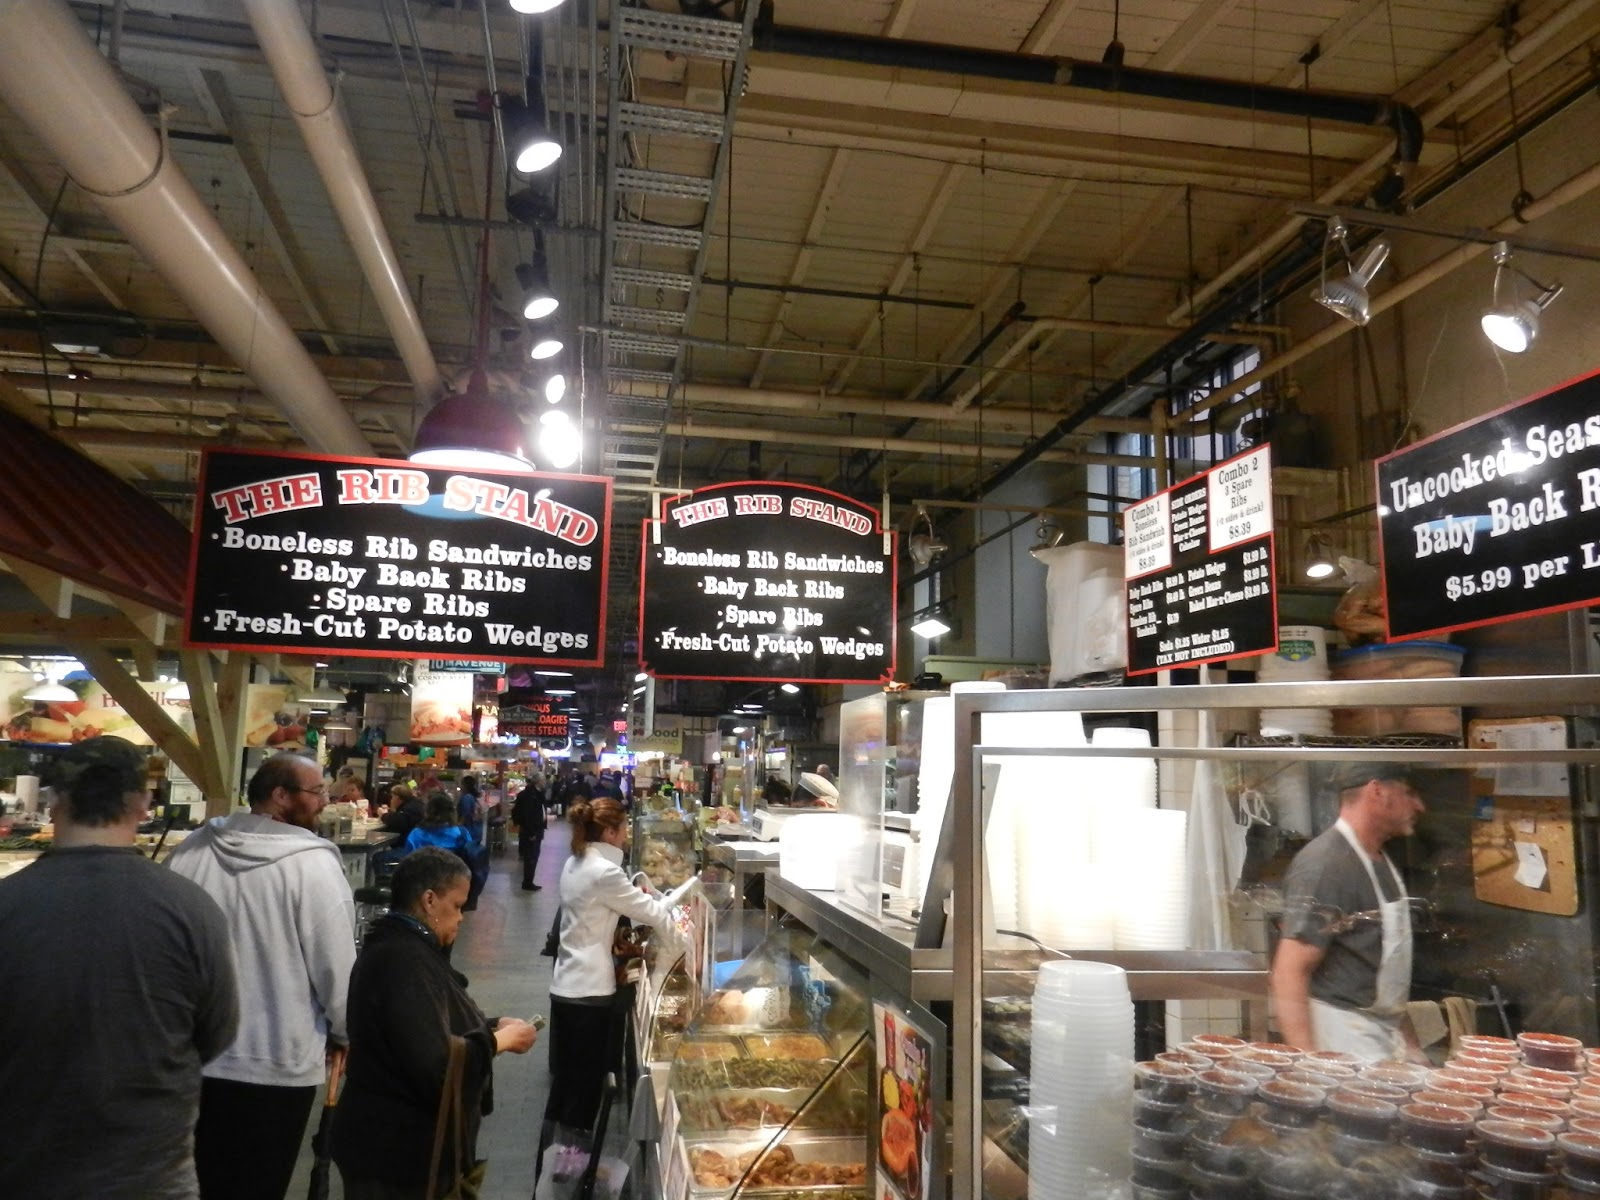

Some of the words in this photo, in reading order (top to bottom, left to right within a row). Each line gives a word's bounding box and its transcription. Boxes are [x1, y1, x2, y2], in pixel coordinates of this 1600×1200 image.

[1218, 463, 1249, 484] Combo
[1253, 457, 1258, 470] 2
[1390, 438, 1516, 513] Uncooked
[1224, 485, 1230, 496] 3
[1232, 478, 1252, 494] Spare
[211, 472, 323, 524] THE
[336, 469, 429, 505] RIB
[443, 475, 598, 546] STAND
[1132, 504, 1154, 522] Combo
[1156, 501, 1160, 512] 1
[1231, 495, 1247, 509] Ribs
[672, 498, 728, 528] THE
[735, 495, 782, 514] RIB
[791, 497, 872, 536] STAND
[1135, 516, 1158, 532] Boneless
[1414, 515, 1477, 558] Baby
[1488, 483, 1567, 537] Back
[1139, 526, 1165, 544] Sandwich
[1228, 521, 1251, 540] $8.39
[223, 527, 353, 556] Boneless
[365, 536, 417, 558] Rib
[428, 539, 592, 571] Sandwiches
[664, 547, 740, 568] Boneless
[747, 551, 778, 570] Rib
[785, 552, 884, 574] Sandwiches
[291, 559, 366, 588] Baby
[377, 564, 450, 589] Back
[461, 569, 526, 593] Ribs
[1188, 568, 1205, 582] Potato
[1205, 562, 1226, 576] Wedges
[1446, 566, 1512, 601] $5.99
[1523, 555, 1569, 589] per
[704, 576, 748, 599] Baby
[755, 578, 798, 597] Back
[804, 581, 844, 599] Ribs
[327, 588, 411, 615] Spare
[423, 593, 489, 617] Ribs
[726, 605, 776, 628] Spare
[783, 608, 823, 626] Ribs
[214, 610, 365, 637] Fresh-Cut
[378, 618, 472, 642] Potato
[484, 623, 588, 652] Wedges
[1159, 640, 1174, 652] Soda
[1191, 633, 1211, 645] Water
[662, 632, 750, 652] Fresh-Cut
[757, 635, 813, 654] Potato
[820, 637, 884, 660] Wedges
[1156, 654, 1173, 666] (TAX
[1175, 650, 1190, 661] NOT
[1192, 640, 1234, 658] INCLUDED)
[538, 716, 568, 724] OAGIES
[539, 726, 567, 735] STEAKS
[653, 728, 678, 737] ood
